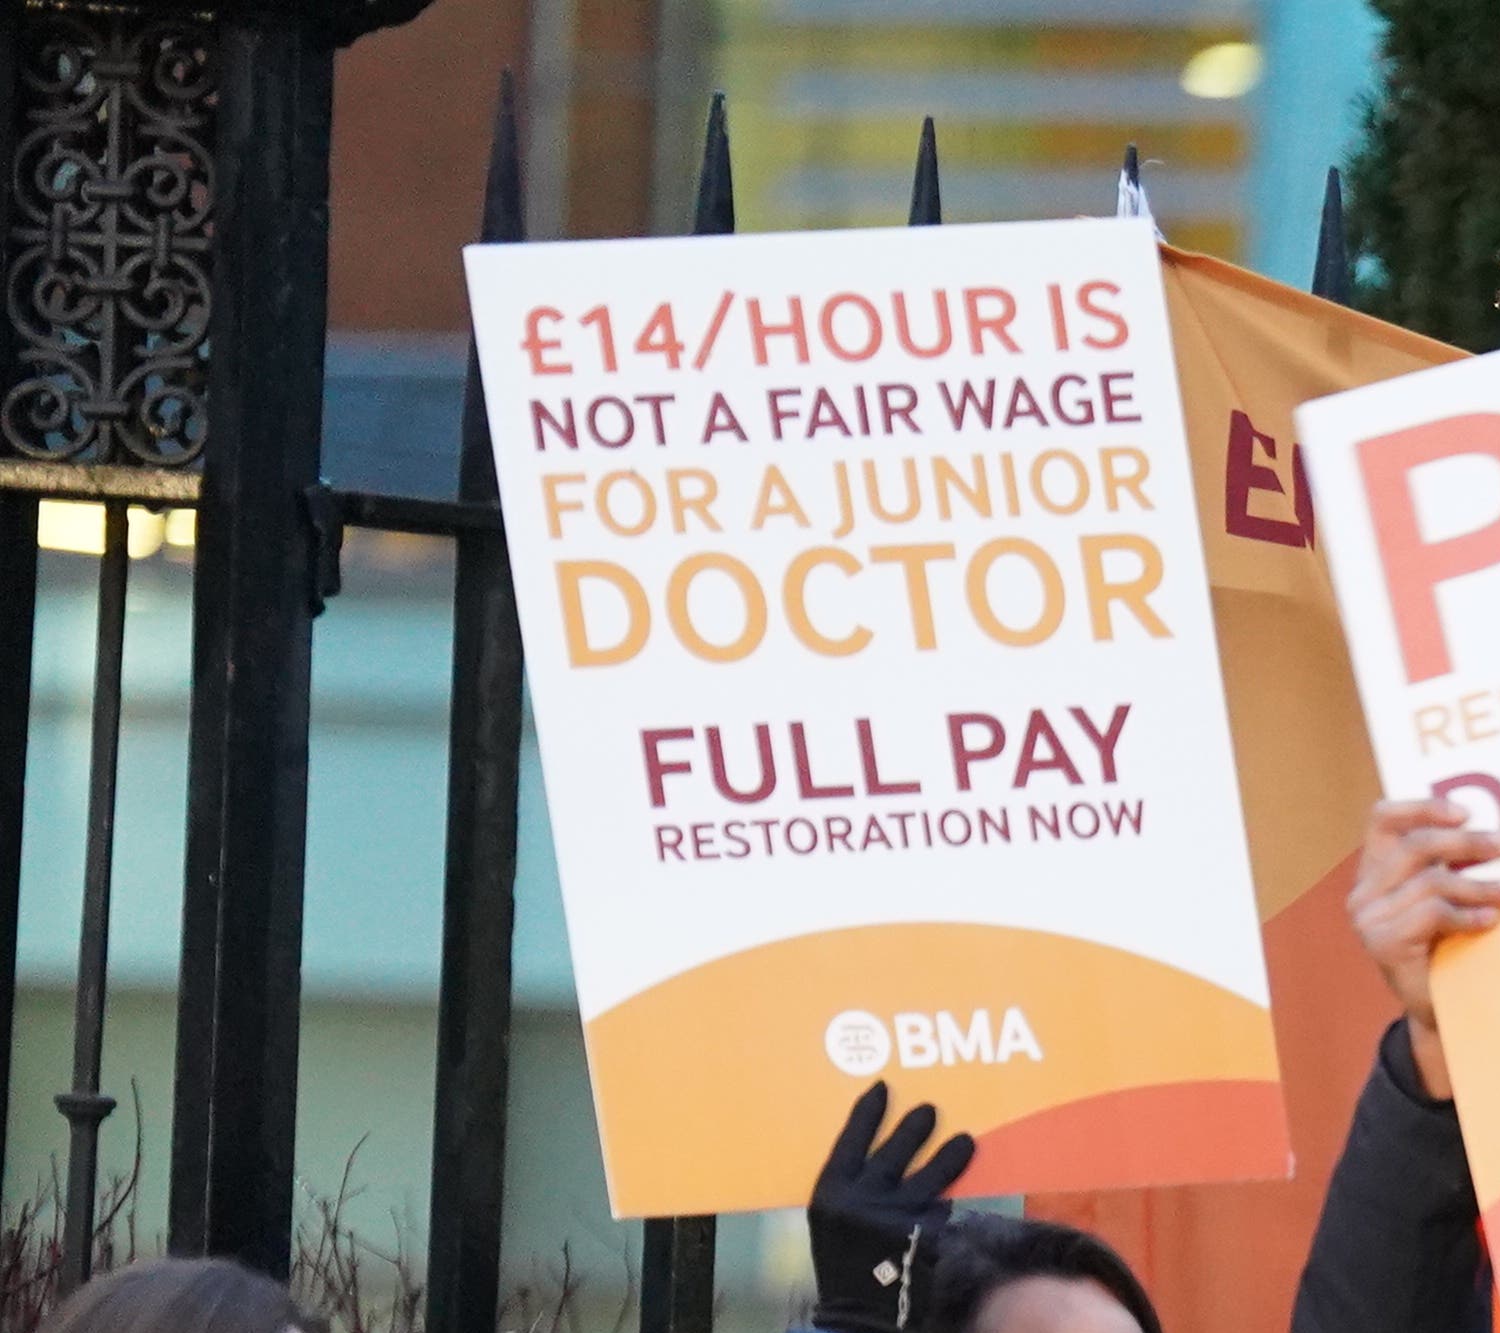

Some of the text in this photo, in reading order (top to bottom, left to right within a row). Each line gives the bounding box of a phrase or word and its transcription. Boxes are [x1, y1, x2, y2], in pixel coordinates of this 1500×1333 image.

[520, 279, 1130, 377] £14/HOUR IS
[531, 372, 1142, 451] NOT A FAIR WAGE
[541, 447, 1156, 539] FOR A JUNIOR
[555, 533, 1175, 669] DOCTOR
[641, 703, 1133, 807] FULL PAY
[655, 801, 1146, 862] RESTORATION NOW
[898, 1008, 1043, 1068] BMA
